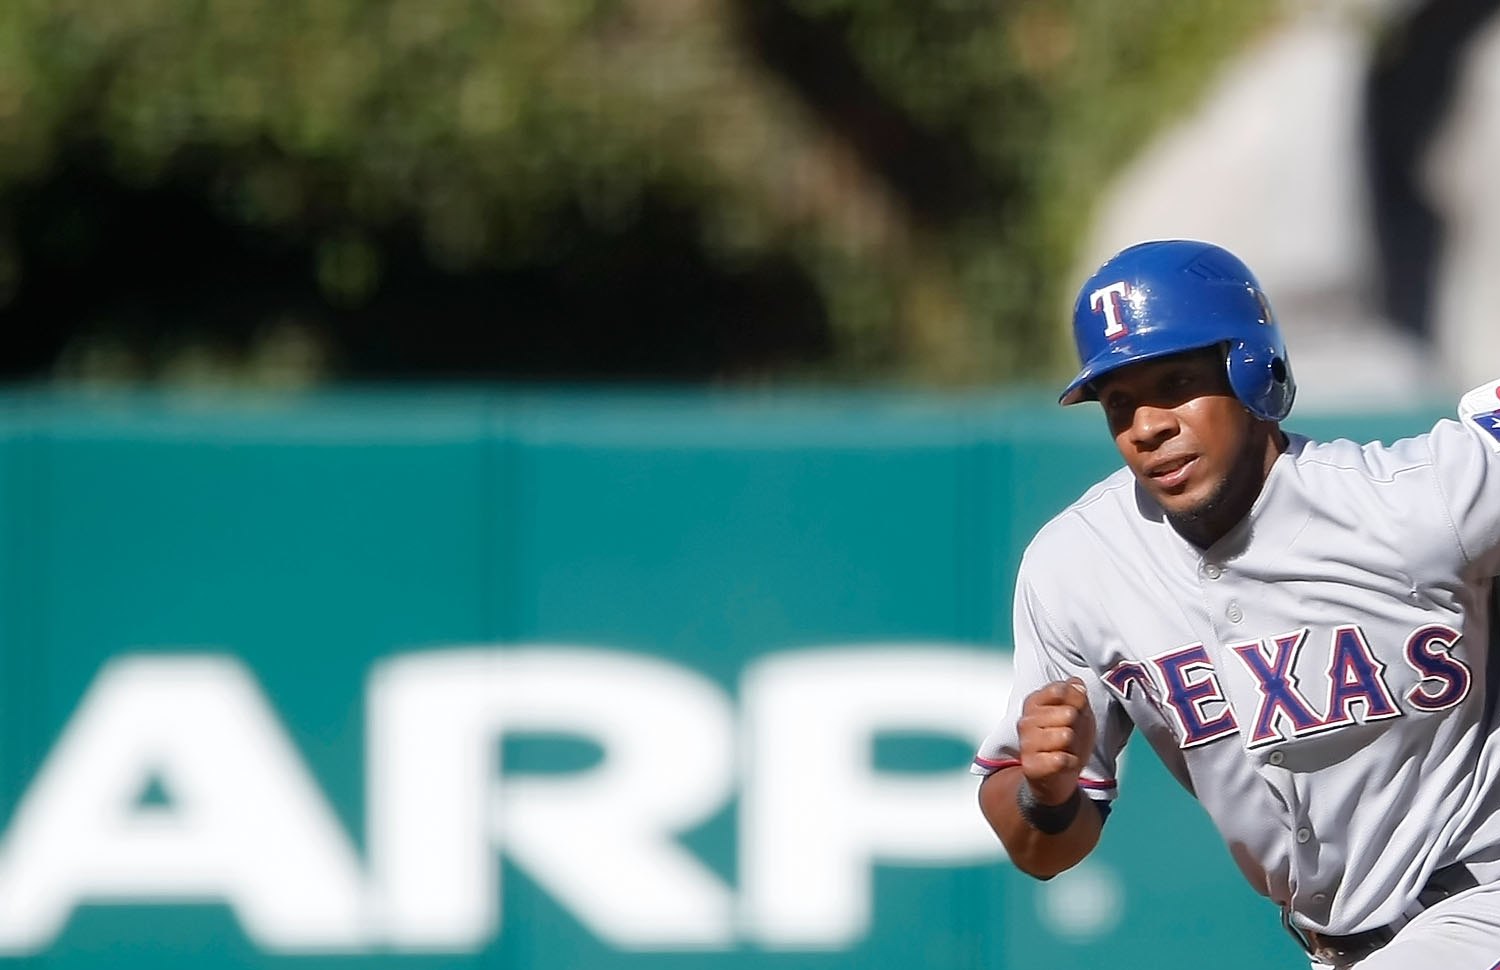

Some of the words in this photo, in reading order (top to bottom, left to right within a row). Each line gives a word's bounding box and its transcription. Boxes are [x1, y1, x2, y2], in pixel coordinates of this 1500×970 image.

[1090, 281, 1129, 341] T
[1101, 624, 1472, 749] TEXAS
[0, 643, 1018, 956] ARP
